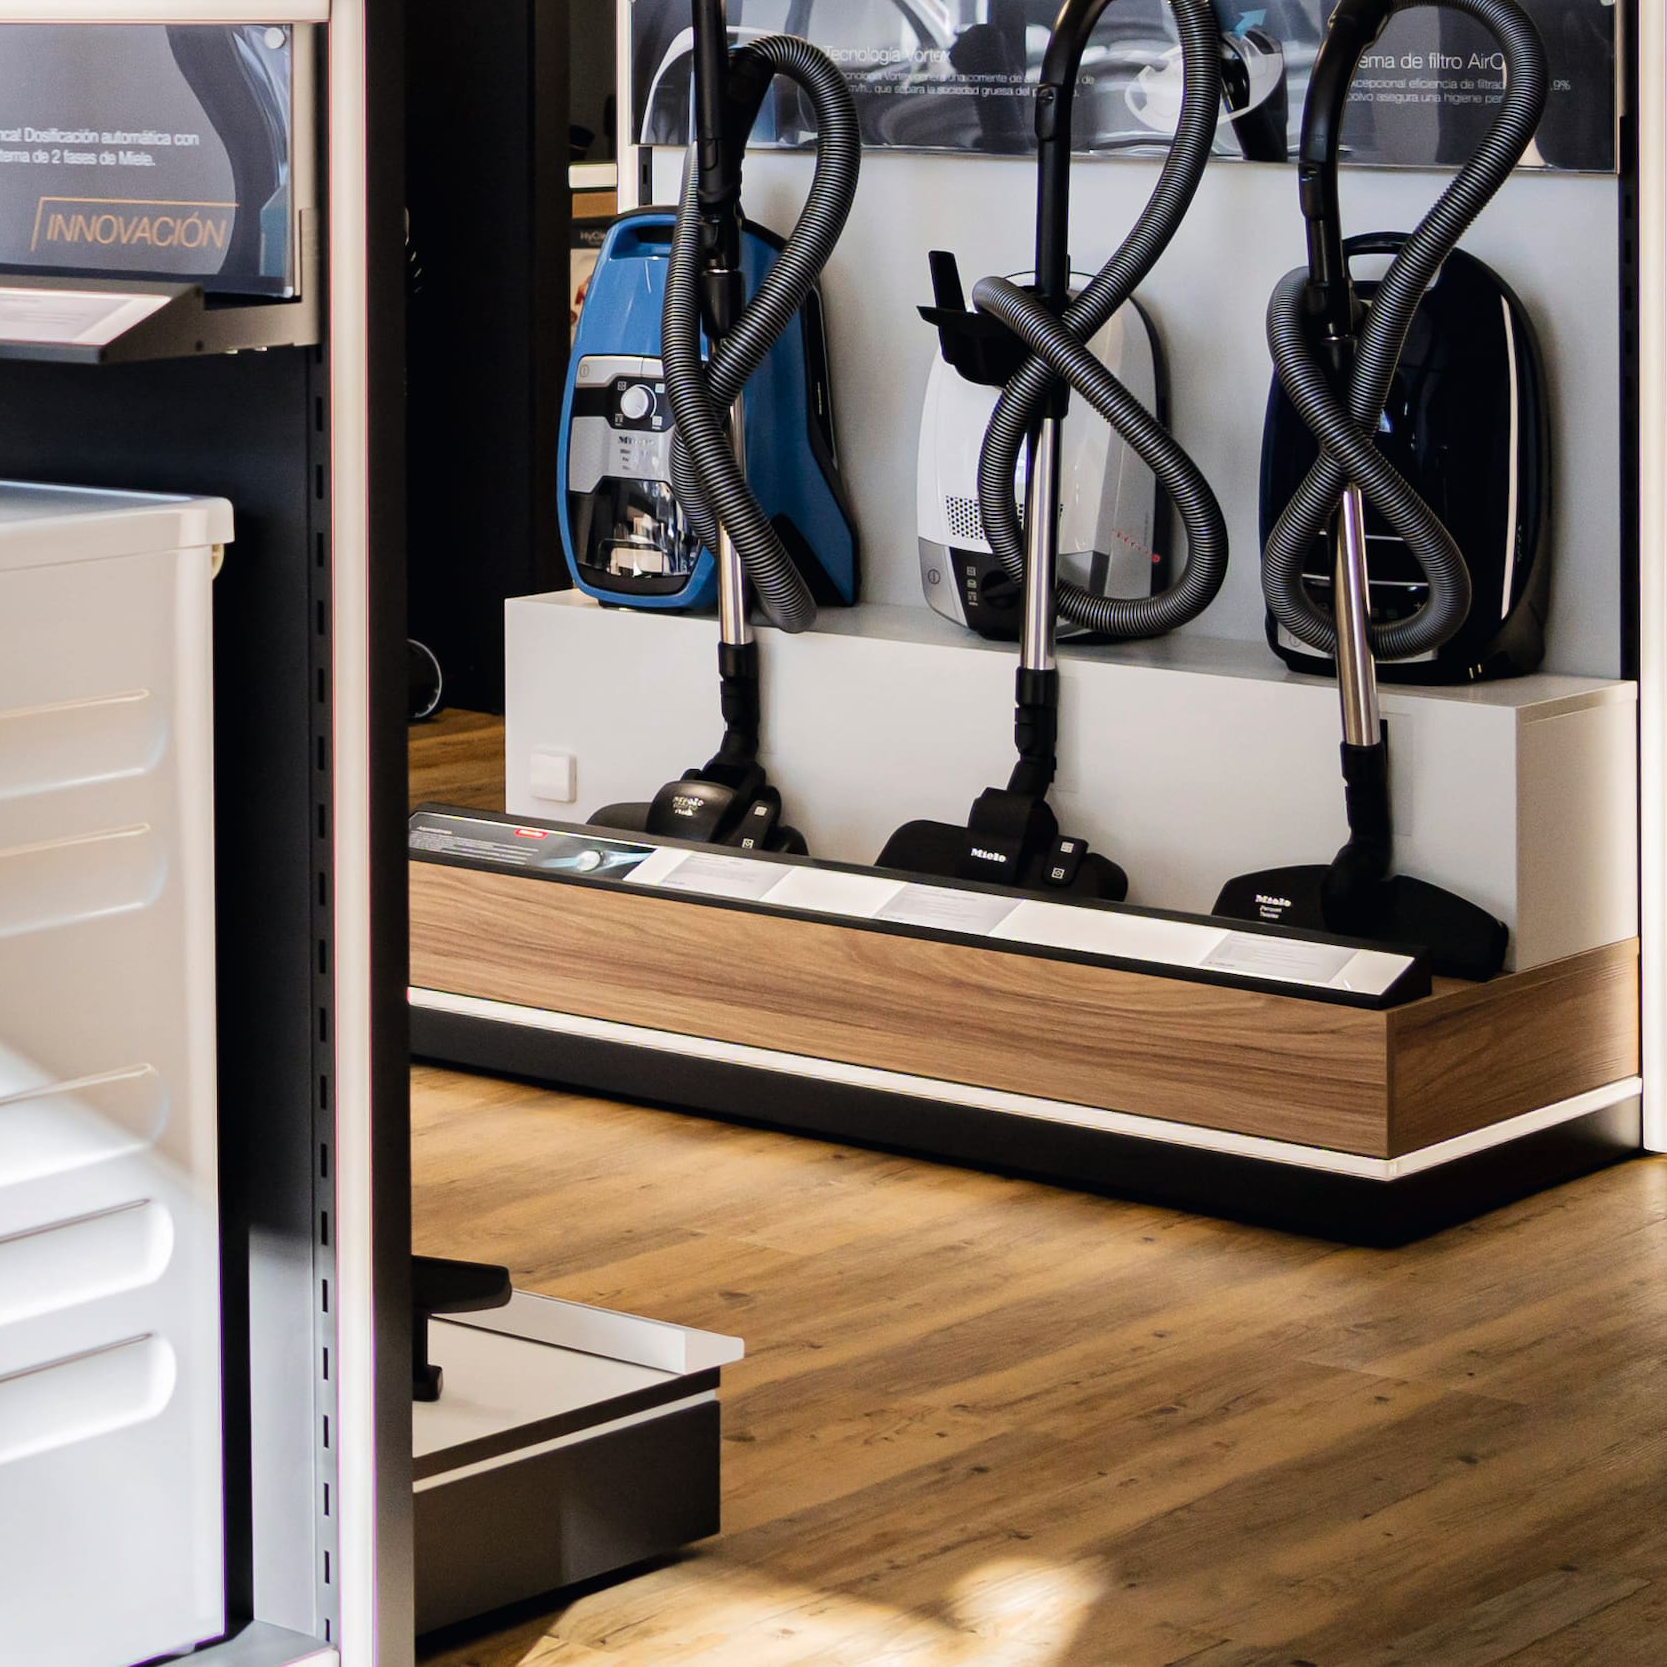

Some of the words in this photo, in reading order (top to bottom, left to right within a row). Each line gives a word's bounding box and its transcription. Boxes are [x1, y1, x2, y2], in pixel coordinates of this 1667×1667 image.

[824, 46, 900, 65] Tecnología
[905, 50, 951, 63] Vortex
[1400, 53, 1423, 69] de
[1429, 53, 1462, 69] filtro
[874, 85, 892, 95] que
[1409, 79, 1457, 89] eficiencia
[1460, 79, 1474, 89] de
[1376, 93, 1419, 104] asegura
[1421, 94, 1441, 102] una
[1444, 92, 1482, 104] higiene
[24, 128, 98, 143] Dosificación
[102, 130, 171, 145] automática
[174, 134, 198, 145] con
[32, 150, 49, 163] de
[52, 150, 60, 164] 2
[64, 150, 96, 165] fases
[99, 151, 115, 165] de
[47, 211, 226, 248] INNOVACIÓN
[971, 847, 1007, 864] Miele
